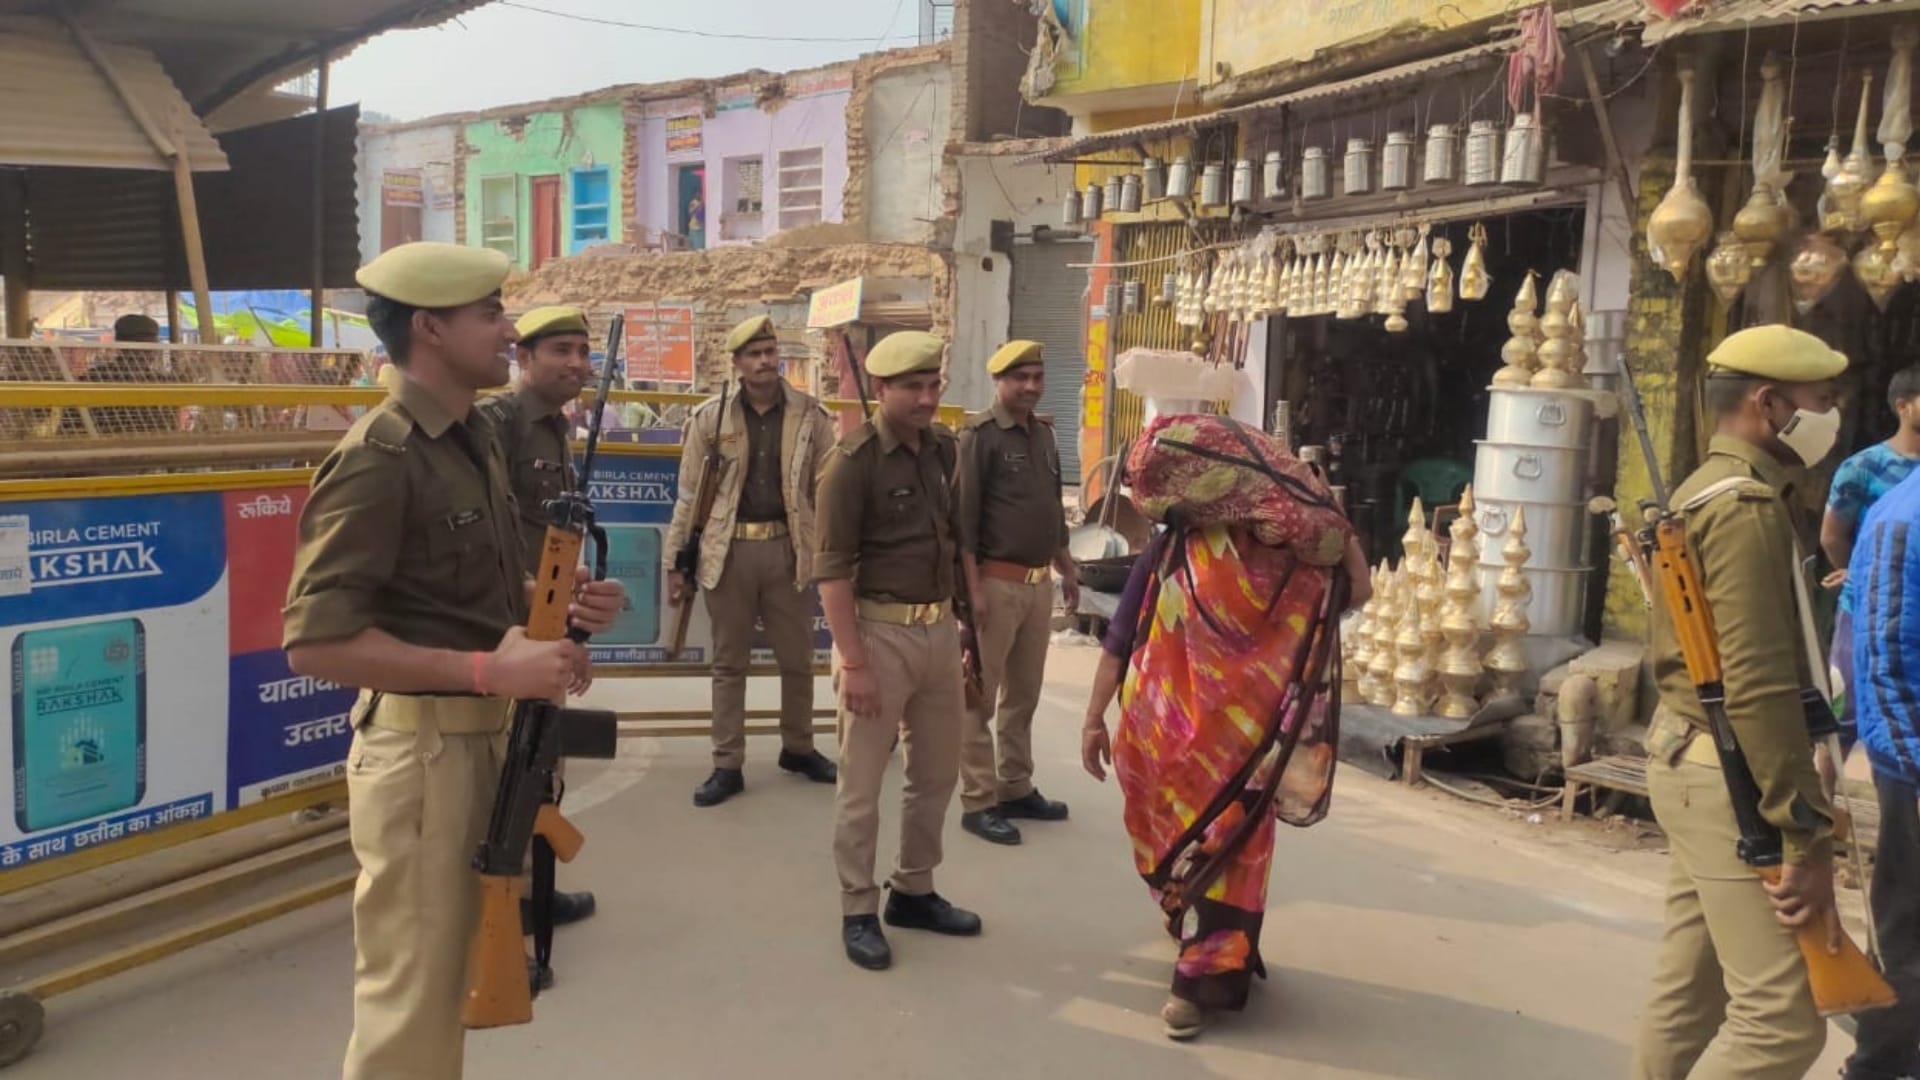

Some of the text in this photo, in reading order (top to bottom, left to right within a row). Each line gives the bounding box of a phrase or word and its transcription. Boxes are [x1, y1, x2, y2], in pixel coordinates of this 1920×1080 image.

[629, 472, 676, 481] CEMENT
[587, 483, 673, 501] AKSHAK
[85, 521, 161, 541] CEMENT
[30, 546, 163, 580] KSHAK
[284, 713, 349, 746] उत्तर
[2, 800, 206, 866] के साथ छत्तीस का आंकड़ा
